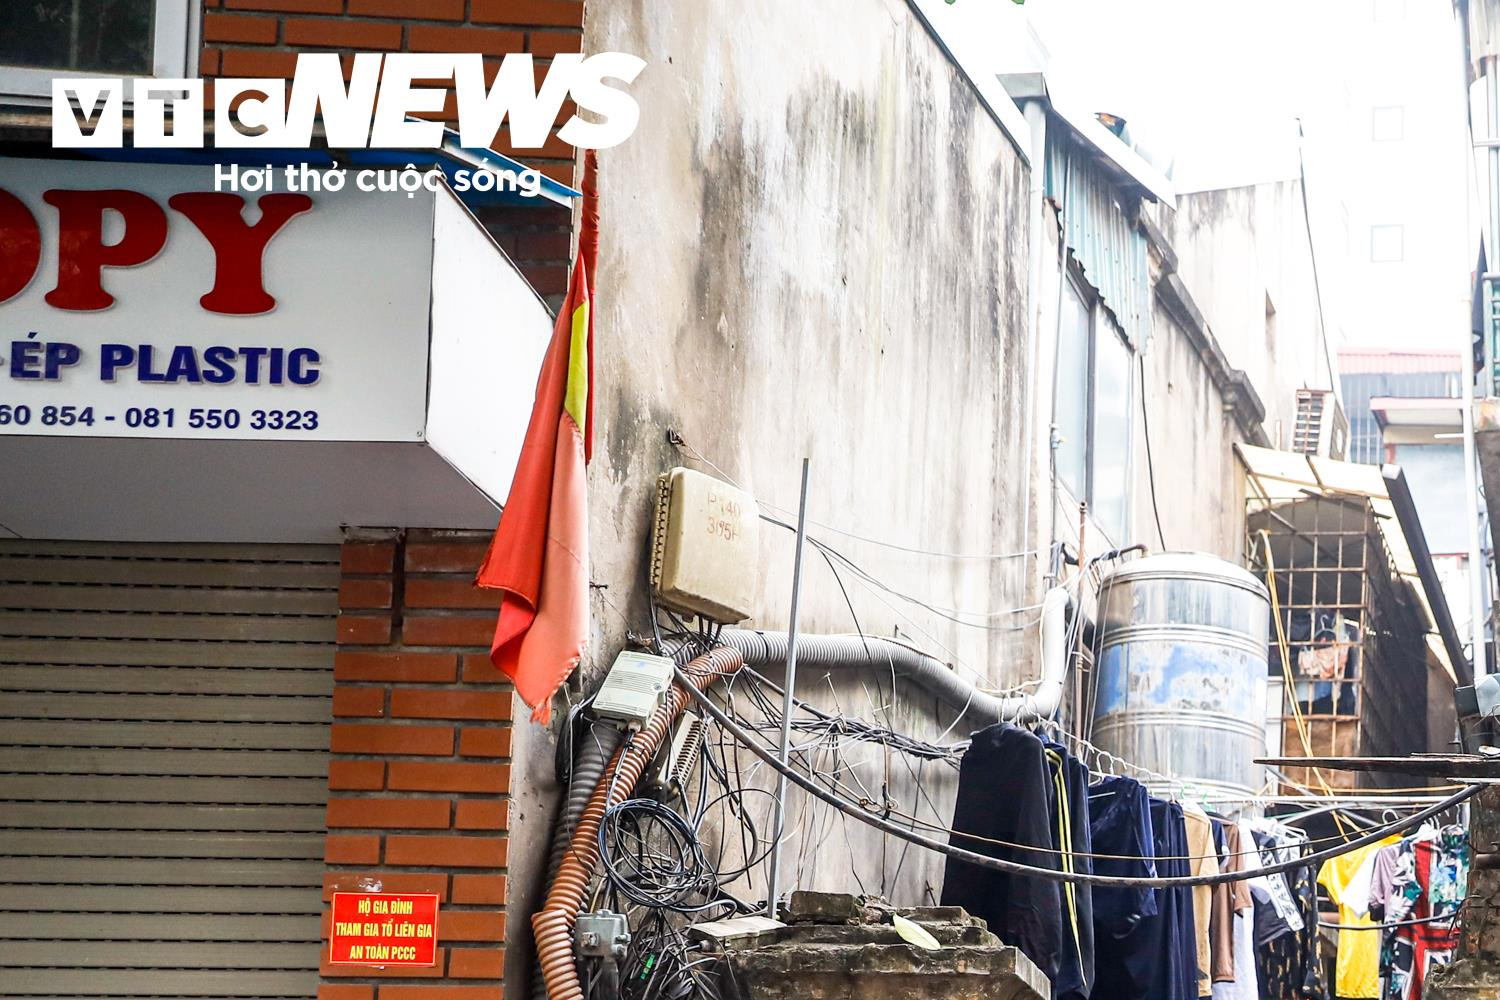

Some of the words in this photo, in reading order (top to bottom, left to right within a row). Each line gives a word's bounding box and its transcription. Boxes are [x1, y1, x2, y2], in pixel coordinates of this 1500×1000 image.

[10, 331, 81, 380] ÉP
[100, 343, 322, 387] PLASTIC
[41, 405, 95, 427] 854
[125, 407, 175, 429] 081
[188, 408, 241, 430] 550
[250, 409, 319, 431] 3323
[358, 897, 371, 917] HỘ
[373, 900, 388, 914] GIA
[390, 898, 413, 915] ĐÌNH
[336, 922, 362, 937] THAM
[363, 923, 379, 937] GIA
[395, 920, 415, 938] LIÊN
[417, 923, 433, 938] GIA
[349, 945, 364, 960] AN
[365, 943, 390, 960] TOÀN
[391, 946, 417, 960] PCCC
